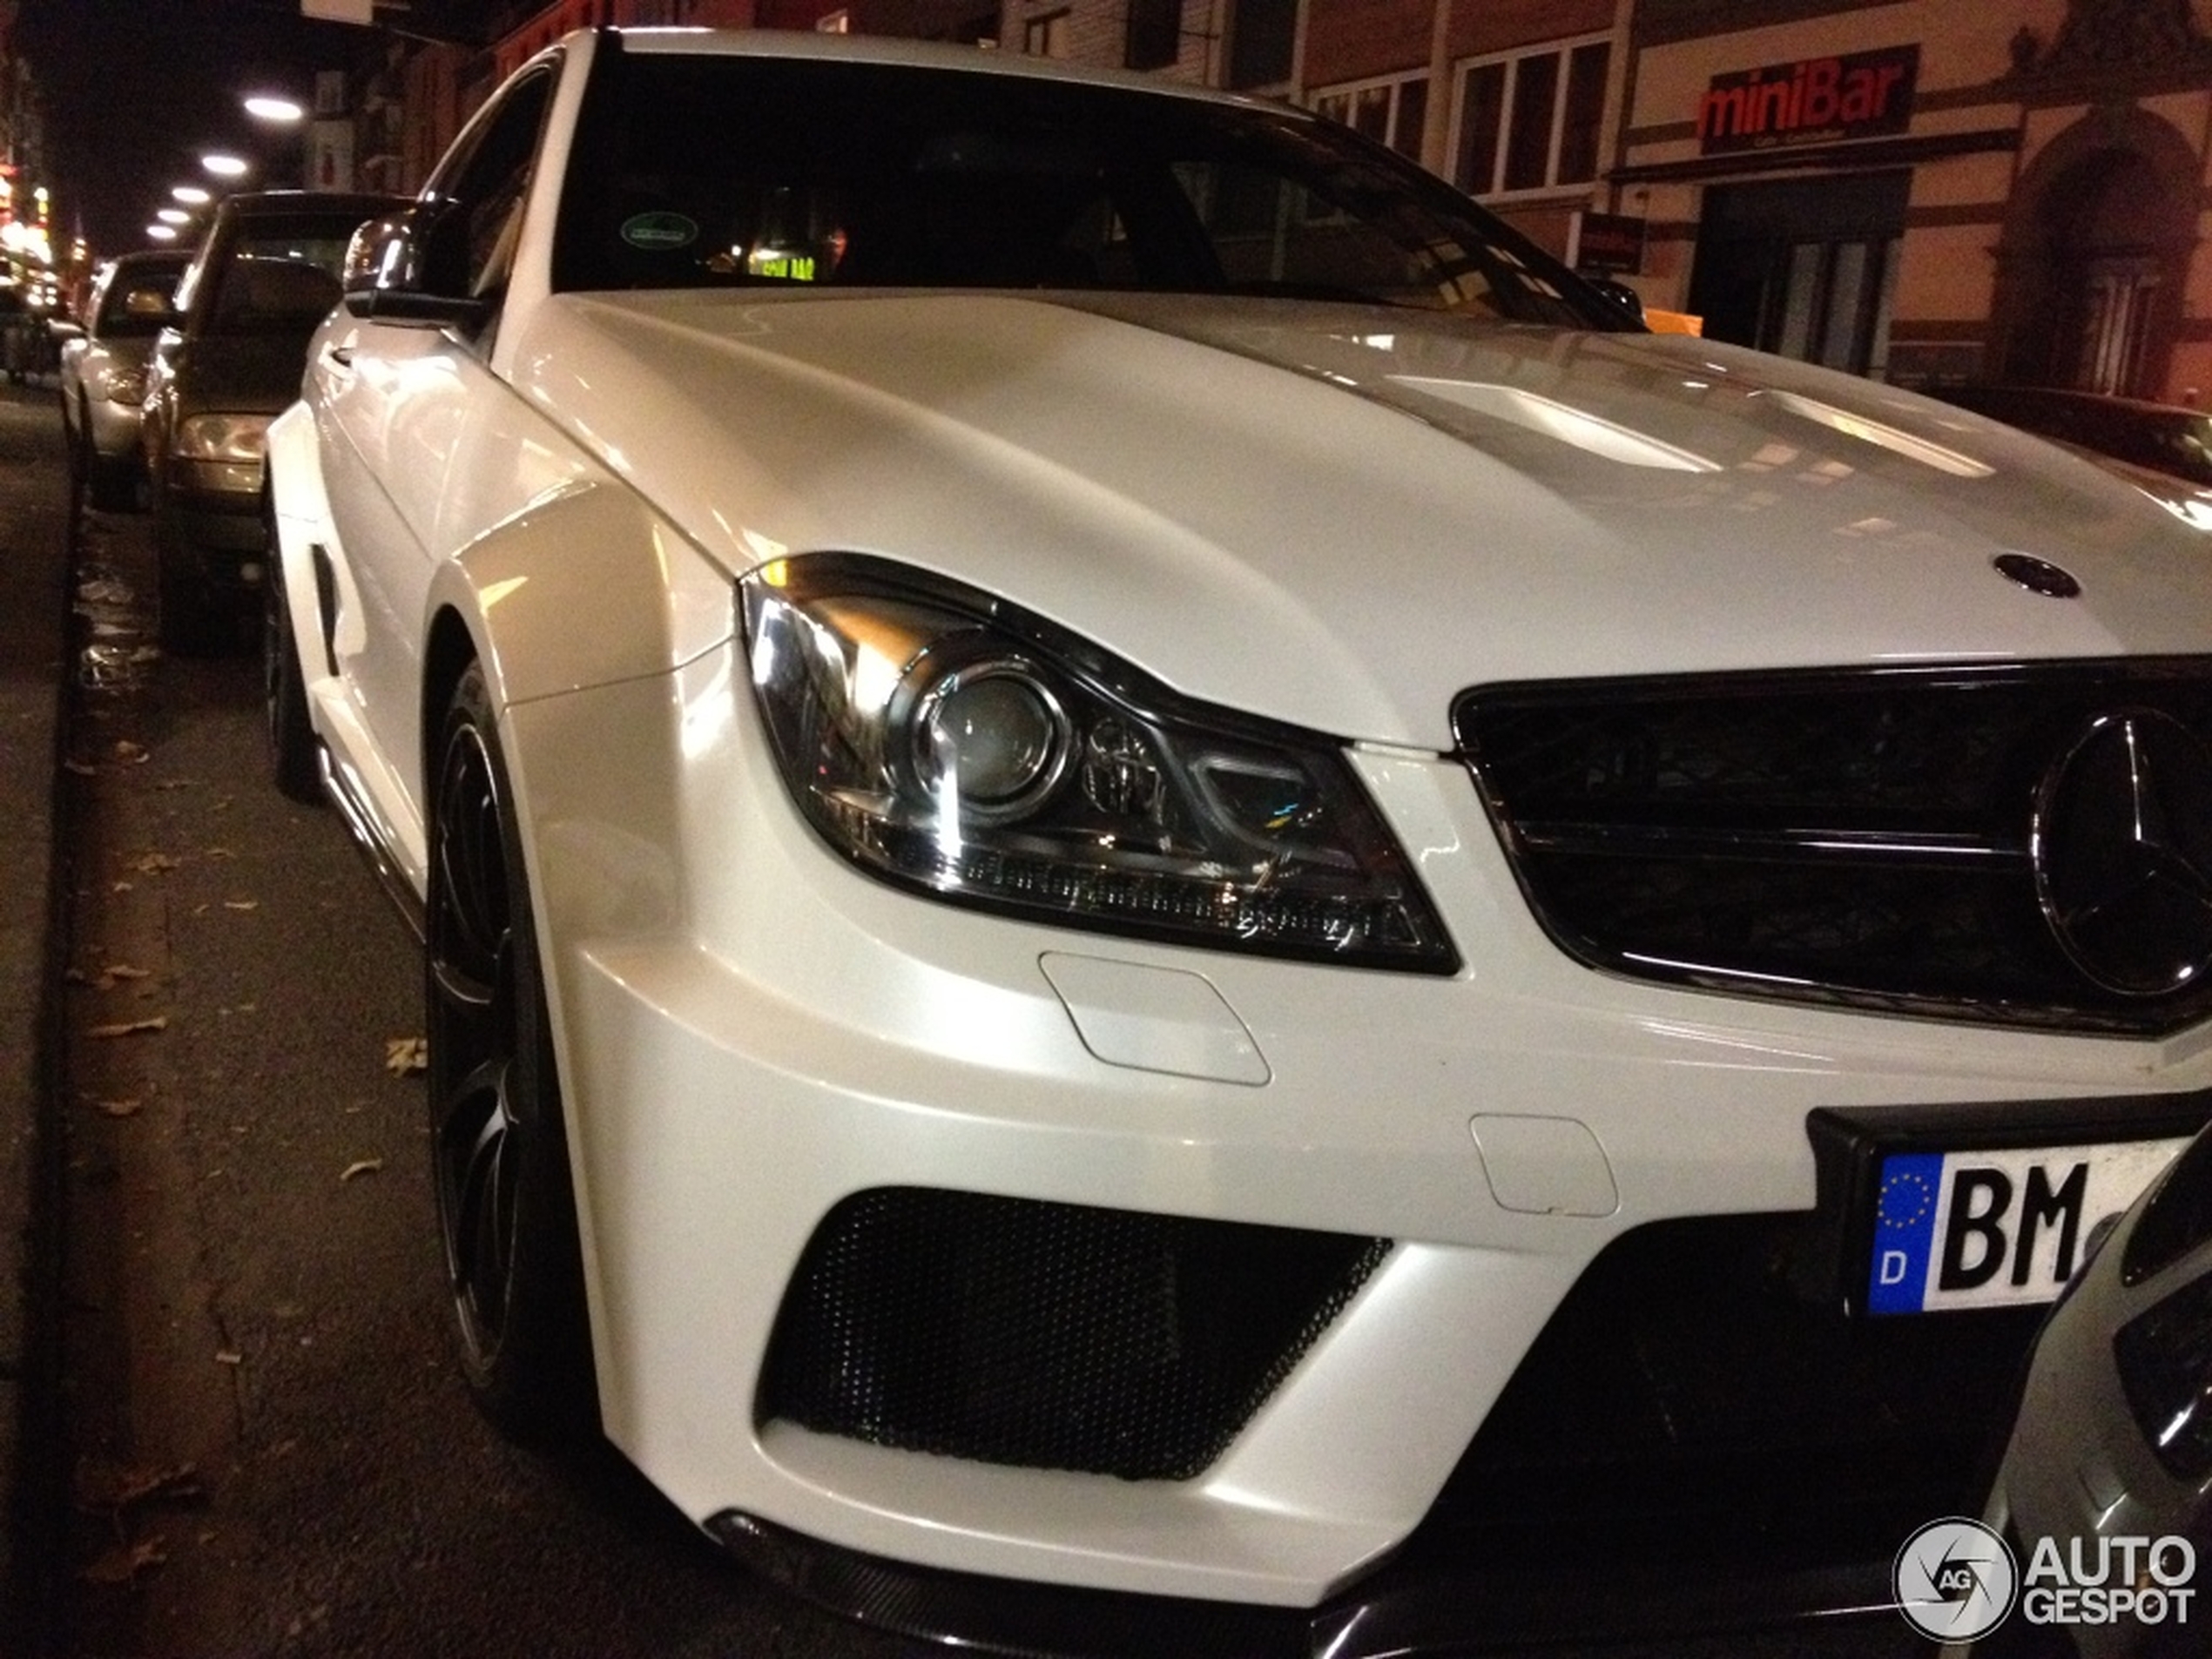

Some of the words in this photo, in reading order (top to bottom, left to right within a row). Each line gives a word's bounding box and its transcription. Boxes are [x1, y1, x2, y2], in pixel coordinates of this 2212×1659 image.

[1698, 57, 1905, 140] miniBar
[1879, 1250, 1907, 1285] D
[1939, 1163, 2089, 1291] BM
